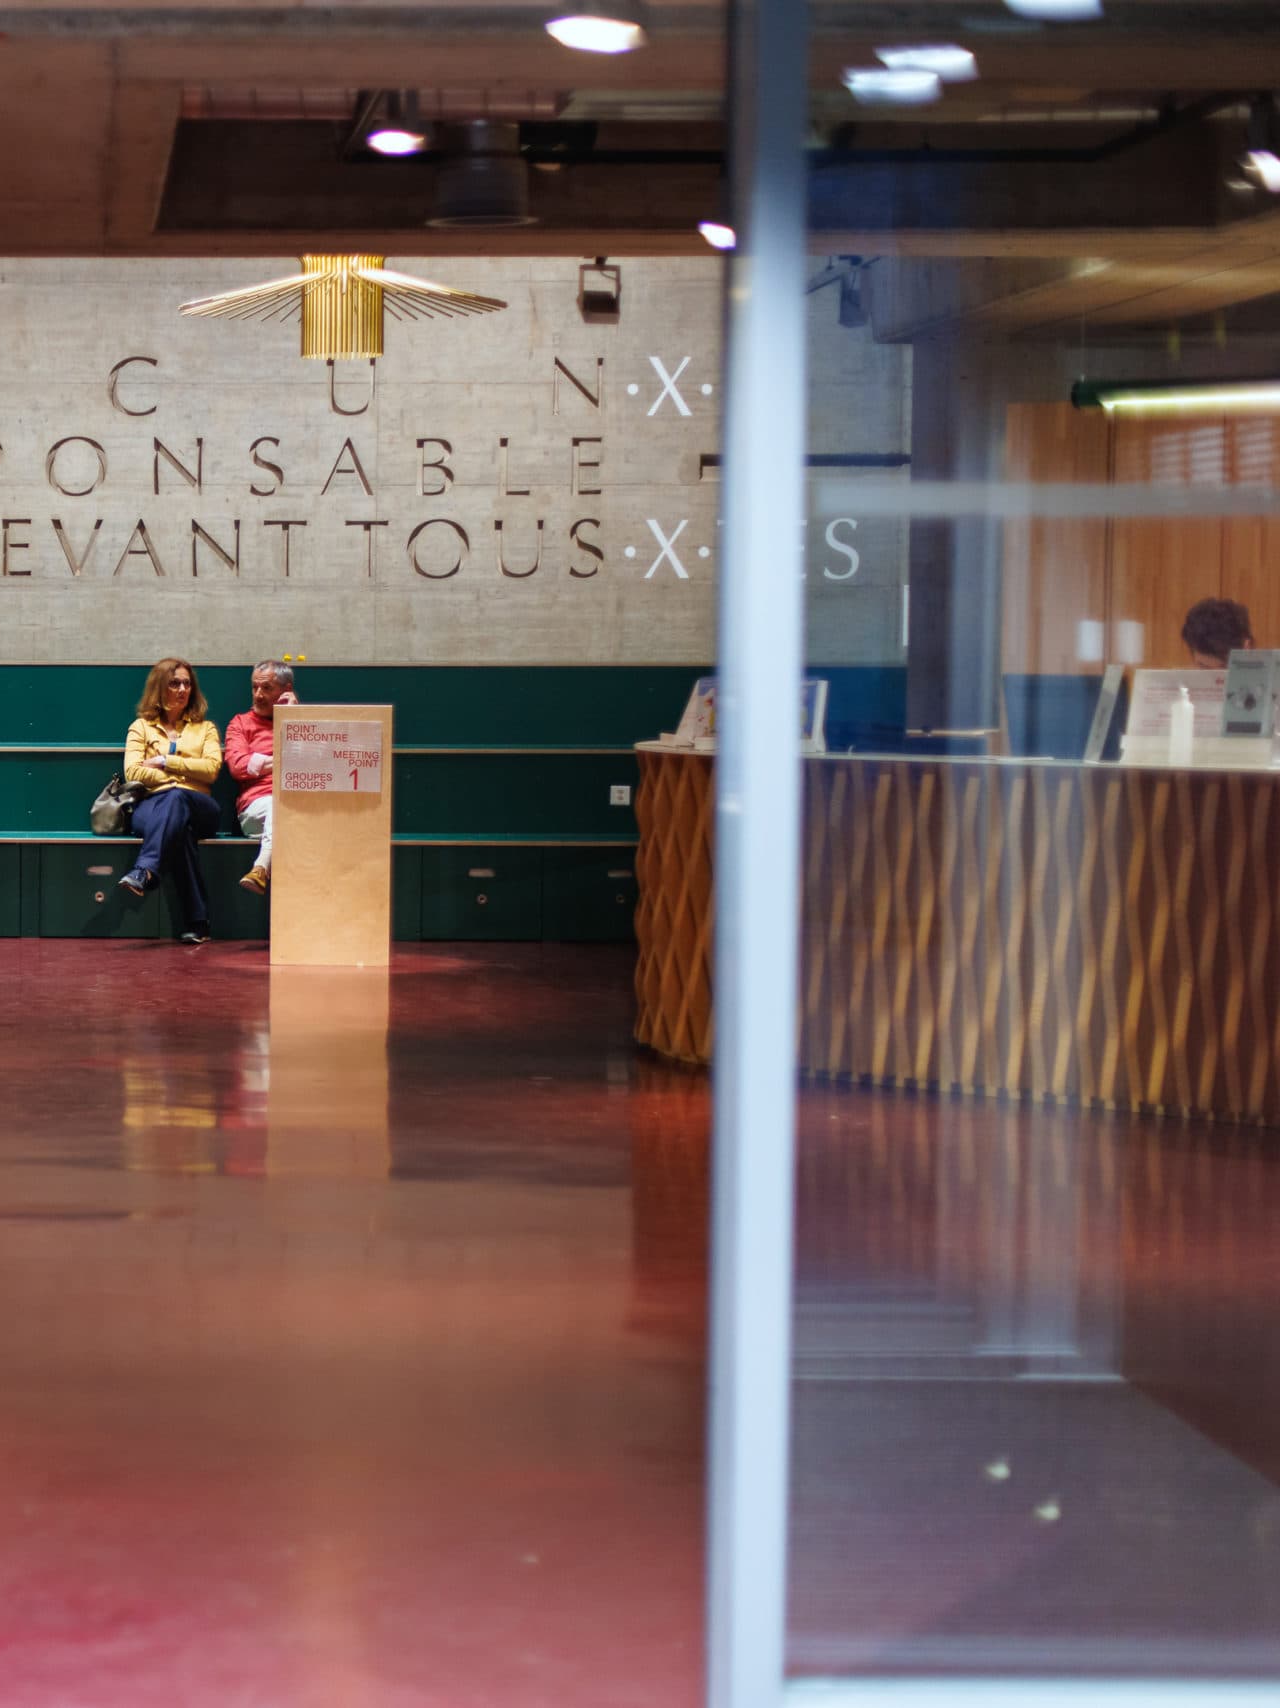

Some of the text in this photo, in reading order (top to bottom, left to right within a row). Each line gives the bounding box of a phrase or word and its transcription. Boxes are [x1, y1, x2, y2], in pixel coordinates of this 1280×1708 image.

[286, 725, 316, 733] POINT
[286, 733, 348, 741] RENCONTRE
[333, 751, 379, 759] MEETING
[285, 773, 332, 781] GROUPES
[349, 769, 358, 790] 1
[285, 781, 326, 789] GROUPS
